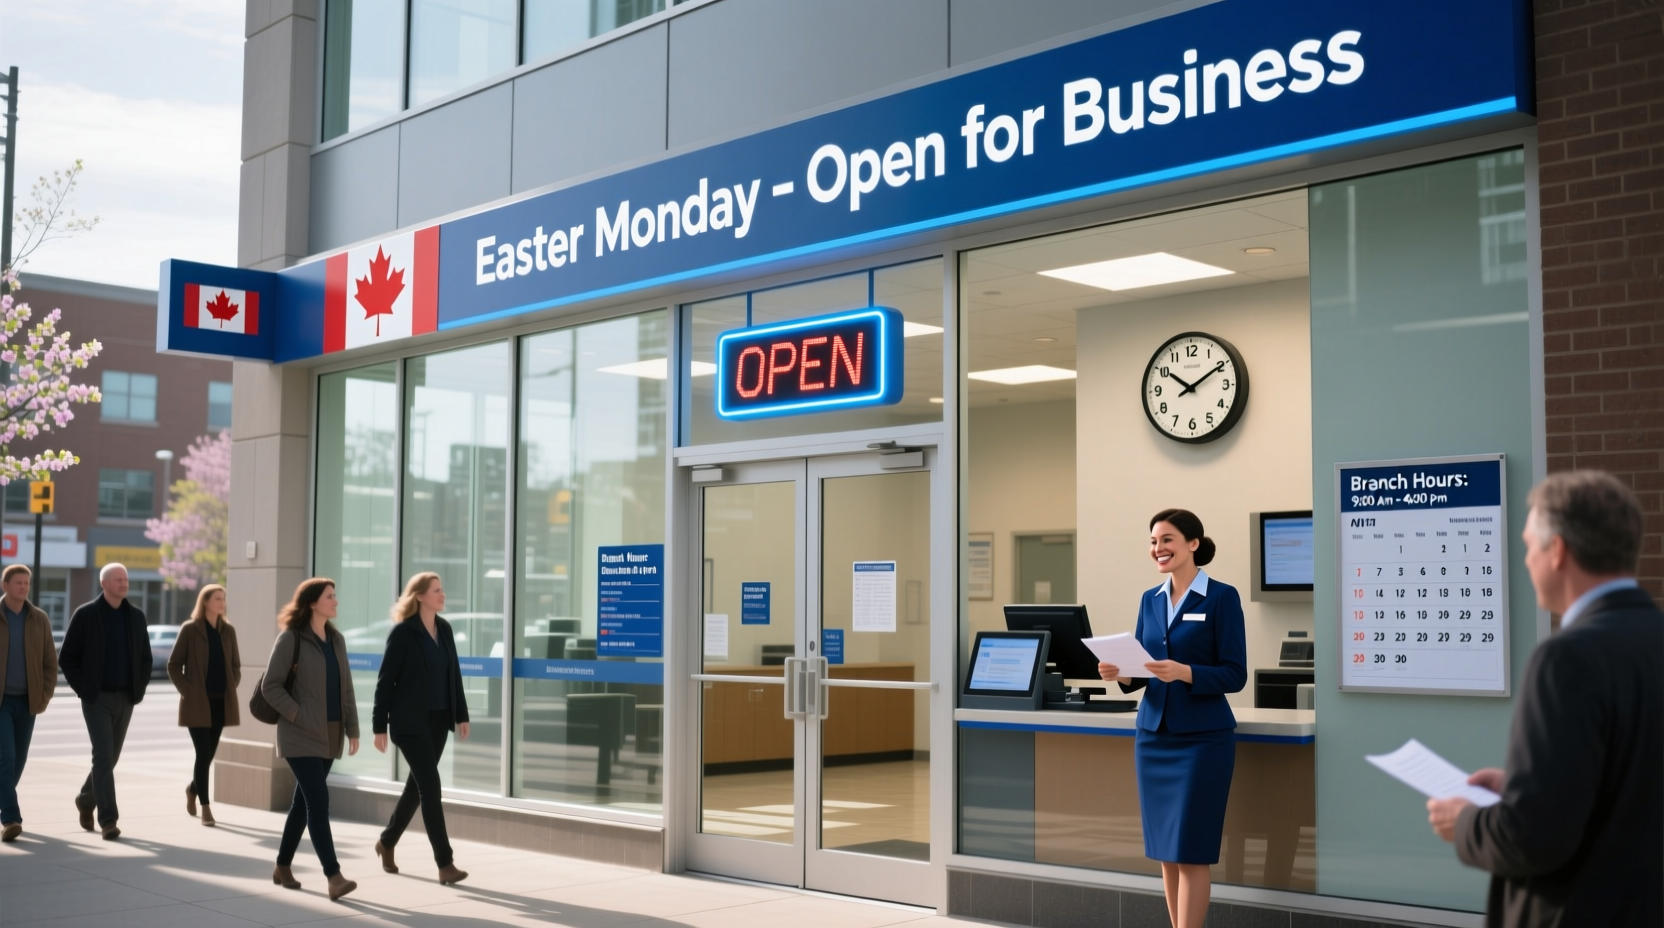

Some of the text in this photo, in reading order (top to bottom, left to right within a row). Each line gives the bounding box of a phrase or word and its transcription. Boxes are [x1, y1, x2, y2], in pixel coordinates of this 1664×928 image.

[476, 224, 584, 285] Easter
[595, 178, 760, 257] Monday
[807, 133, 945, 212] Open
[961, 104, 1045, 169] for
[1063, 30, 1365, 146] Business
[1186, 345, 1198, 357] 12
[1207, 349, 1210, 359] 1
[1171, 352, 1179, 363] 11
[736, 332, 864, 398] OPEN
[1216, 361, 1225, 373] 2
[1160, 366, 1170, 378] 10
[1222, 379, 1230, 390] 3
[1154, 385, 1162, 397] 9
[1160, 402, 1167, 414] 8
[1217, 398, 1224, 408] 4
[1172, 414, 1179, 427] 7
[1189, 418, 1196, 430] 6
[1206, 412, 1213, 424] 5
[1350, 472, 1469, 491] Branch Hours:
[1430, 493, 1448, 506] pm
[1484, 543, 1490, 552] 2
[1377, 567, 1382, 576] 7
[1420, 567, 1426, 576] 6
[1395, 610, 1406, 619] 16
[1374, 654, 1386, 663] 30
